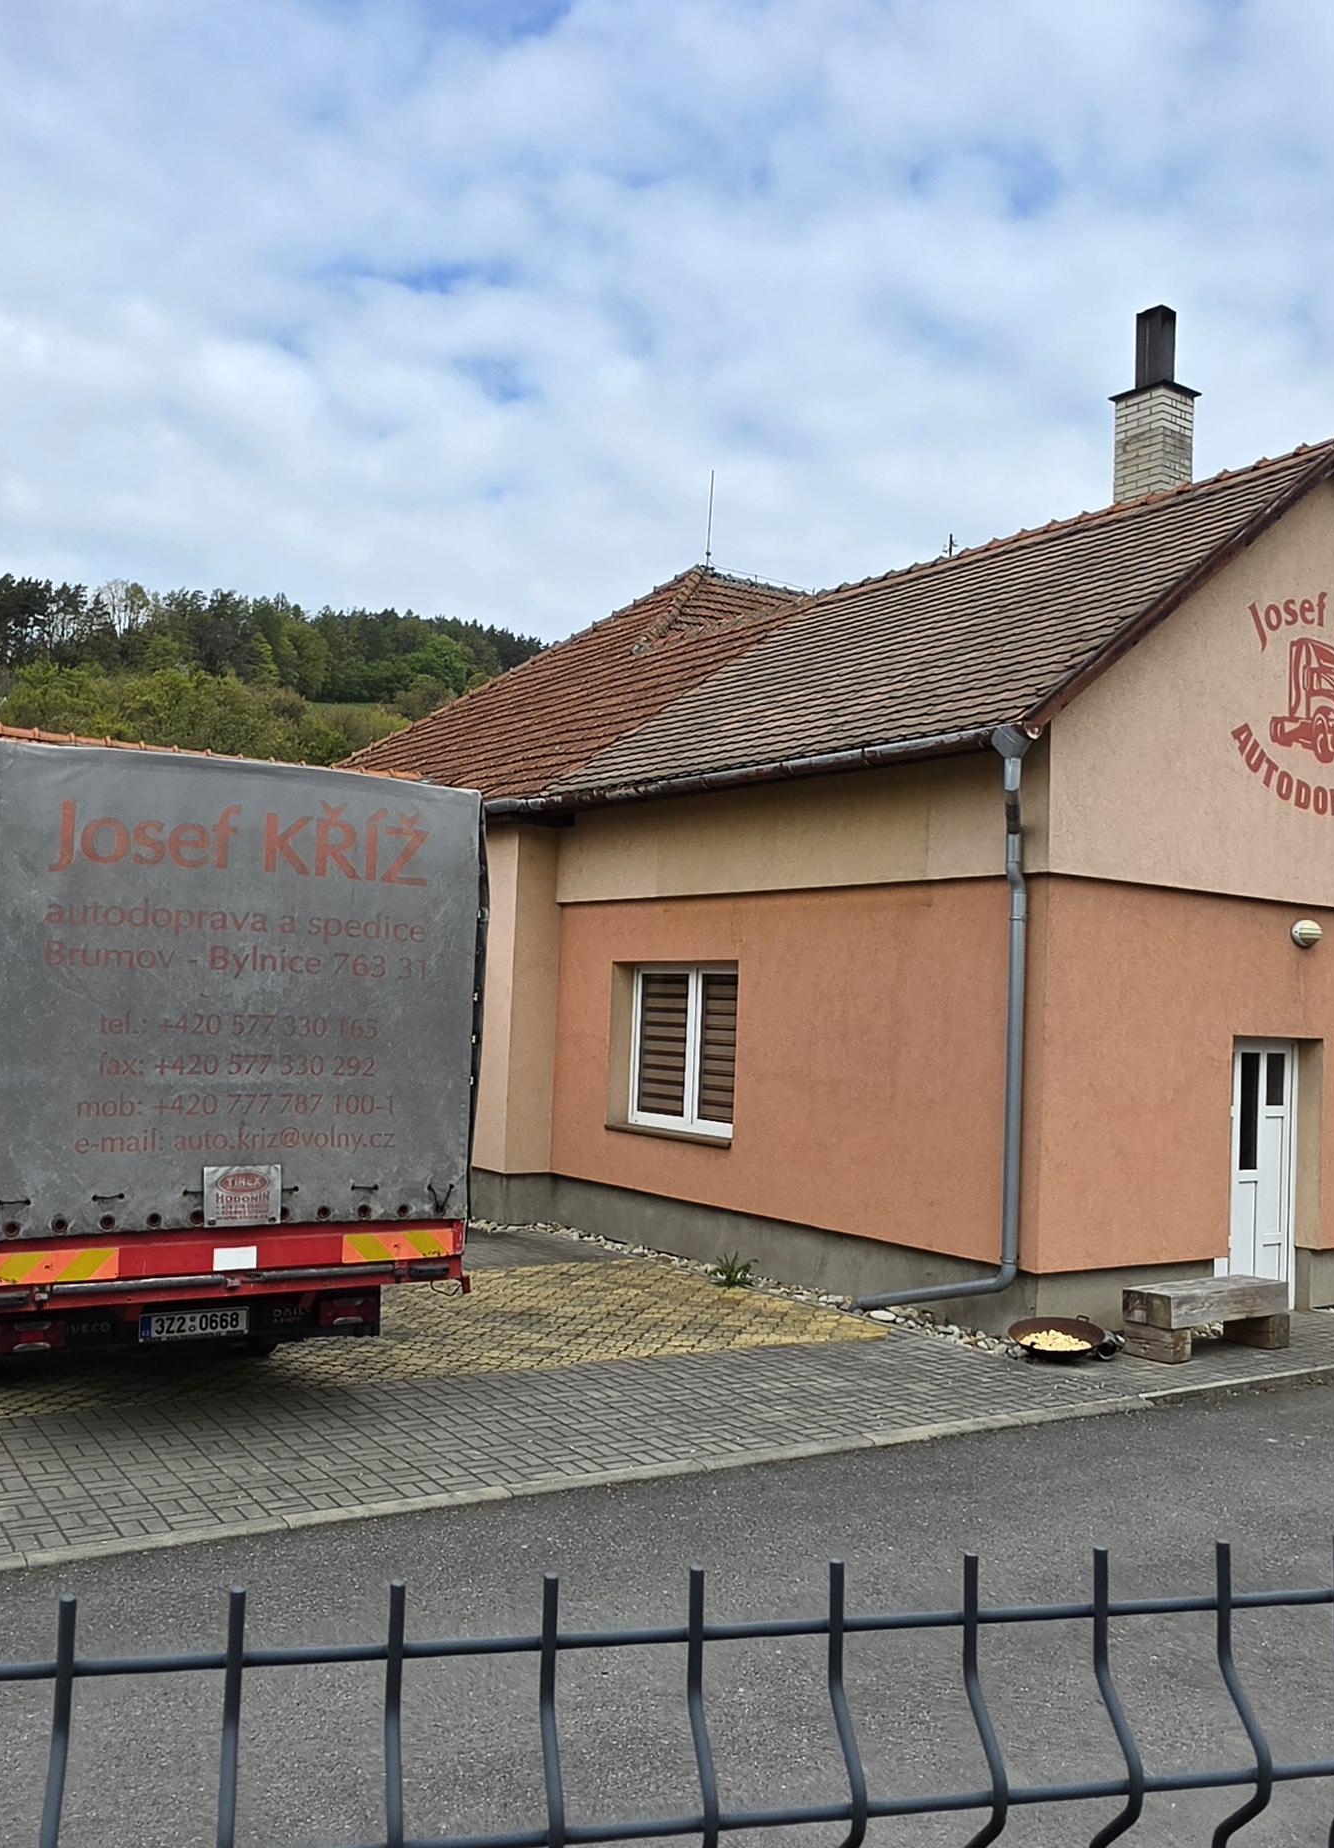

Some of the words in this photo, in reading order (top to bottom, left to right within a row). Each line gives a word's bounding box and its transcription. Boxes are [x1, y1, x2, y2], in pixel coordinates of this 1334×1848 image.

[1247, 591, 1327, 653] Josef
[48, 799, 242, 873] Josef
[265, 799, 430, 888] KŘÍŽ
[44, 898, 268, 936] autodoprava
[279, 914, 296, 934] a
[308, 913, 426, 945] spedice
[43, 939, 176, 969] Brumov
[209, 945, 322, 979] Bylnice
[333, 952, 387, 978] 763
[398, 957, 428, 980] 31
[99, 1011, 147, 1034] tel.:
[158, 1013, 222, 1036] +420
[232, 1013, 275, 1036] 577
[283, 1015, 327, 1038] 330
[338, 1016, 378, 1040] 165
[98, 1051, 143, 1076] fax:
[154, 1054, 220, 1076] +420
[228, 1054, 272, 1076] 577
[281, 1054, 324, 1077] 330
[332, 1055, 376, 1078] 292
[76, 1093, 144, 1119] mob:
[154, 1094, 218, 1117] +420
[227, 1093, 272, 1116] 777
[279, 1094, 323, 1116] 787
[334, 1094, 395, 1116] 100-1
[74, 1127, 164, 1155] e-mail:
[173, 1124, 396, 1155] auto.kriz@volny.cz
[155, 1316, 186, 1335] 3Z2
[199, 1312, 239, 1331] 0668
